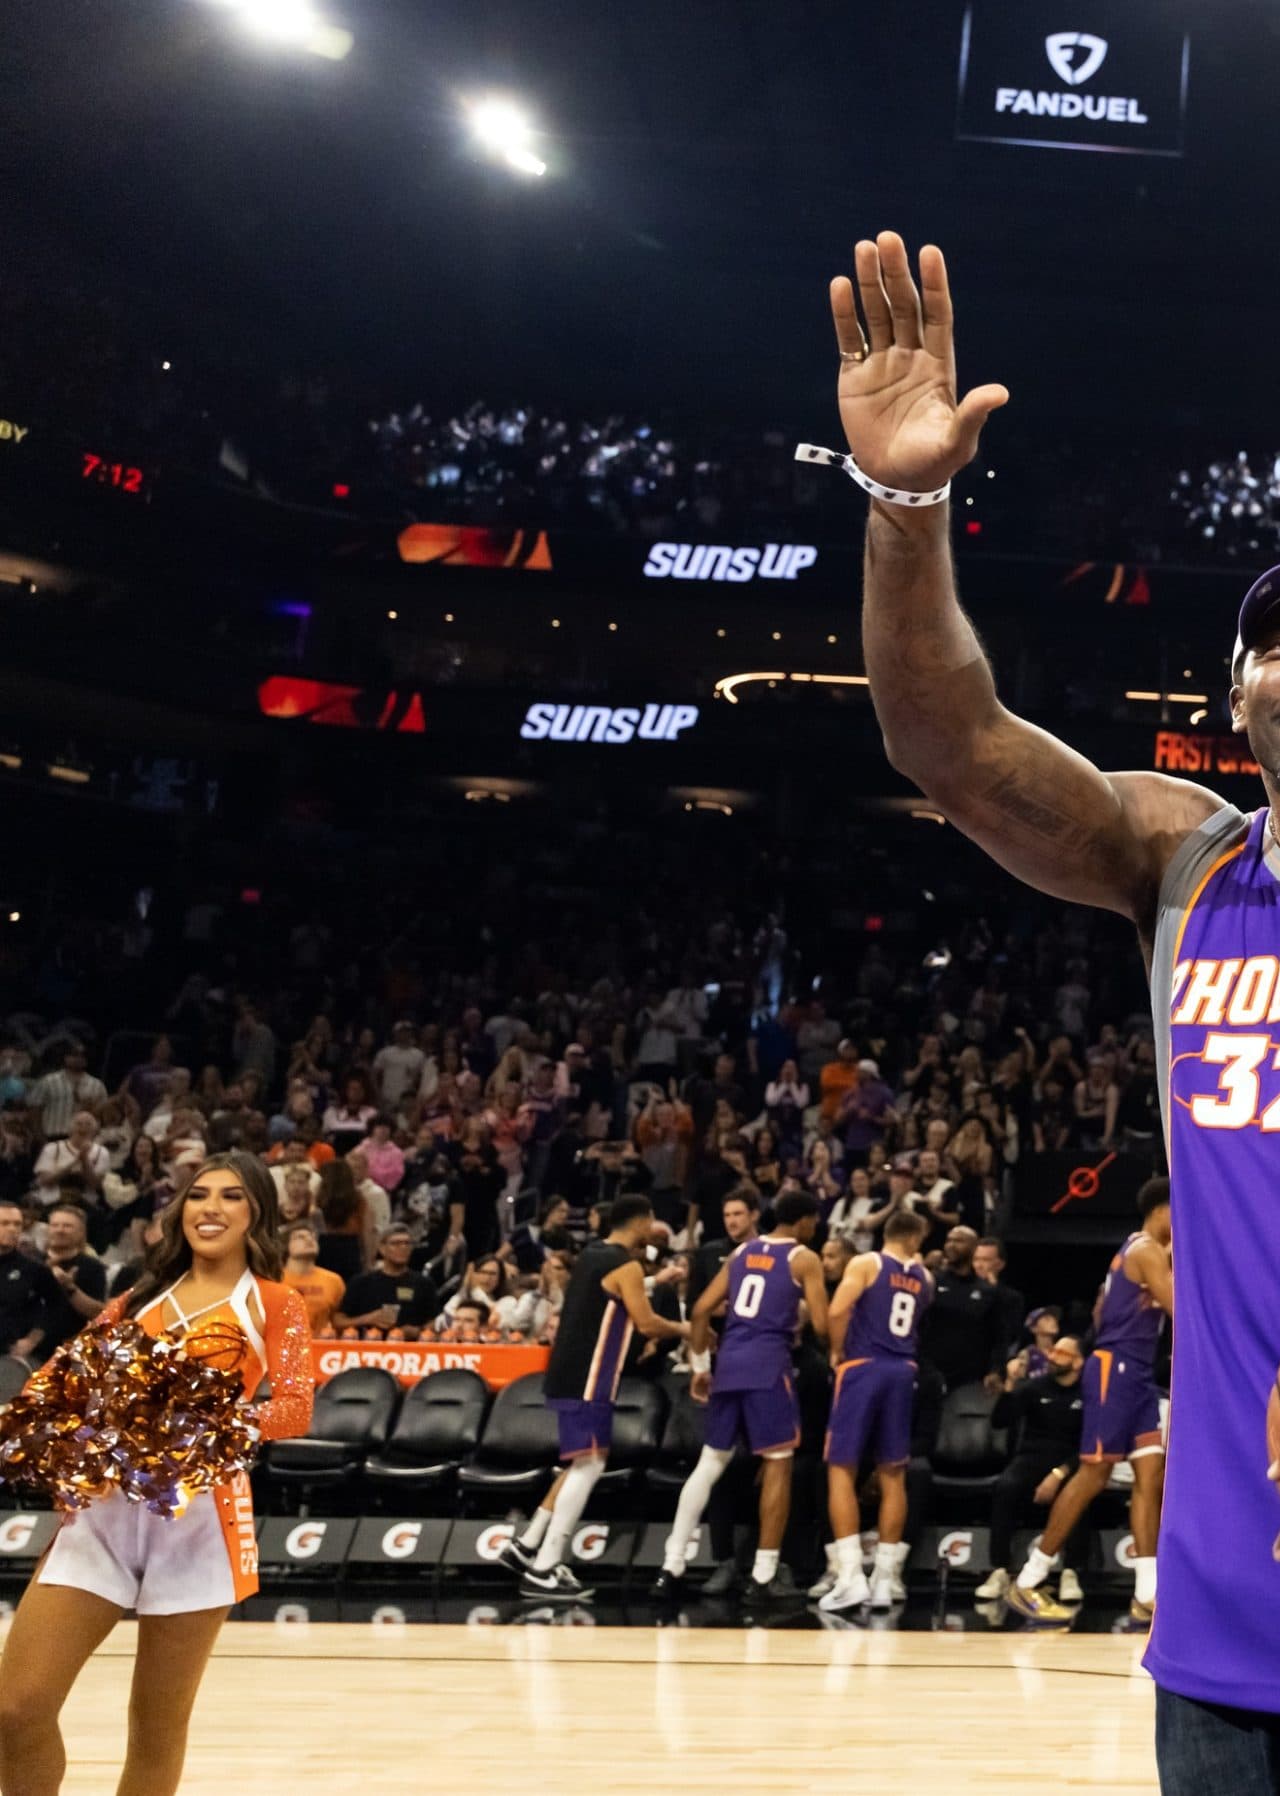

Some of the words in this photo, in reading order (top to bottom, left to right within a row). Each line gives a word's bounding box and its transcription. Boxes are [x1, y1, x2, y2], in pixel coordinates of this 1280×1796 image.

[995, 88, 1148, 124] FANDUEL
[82, 453, 143, 492] 7:12
[734, 1273, 766, 1318] 0
[888, 1291, 916, 1338] 8
[319, 1351, 481, 1376] GATORADE
